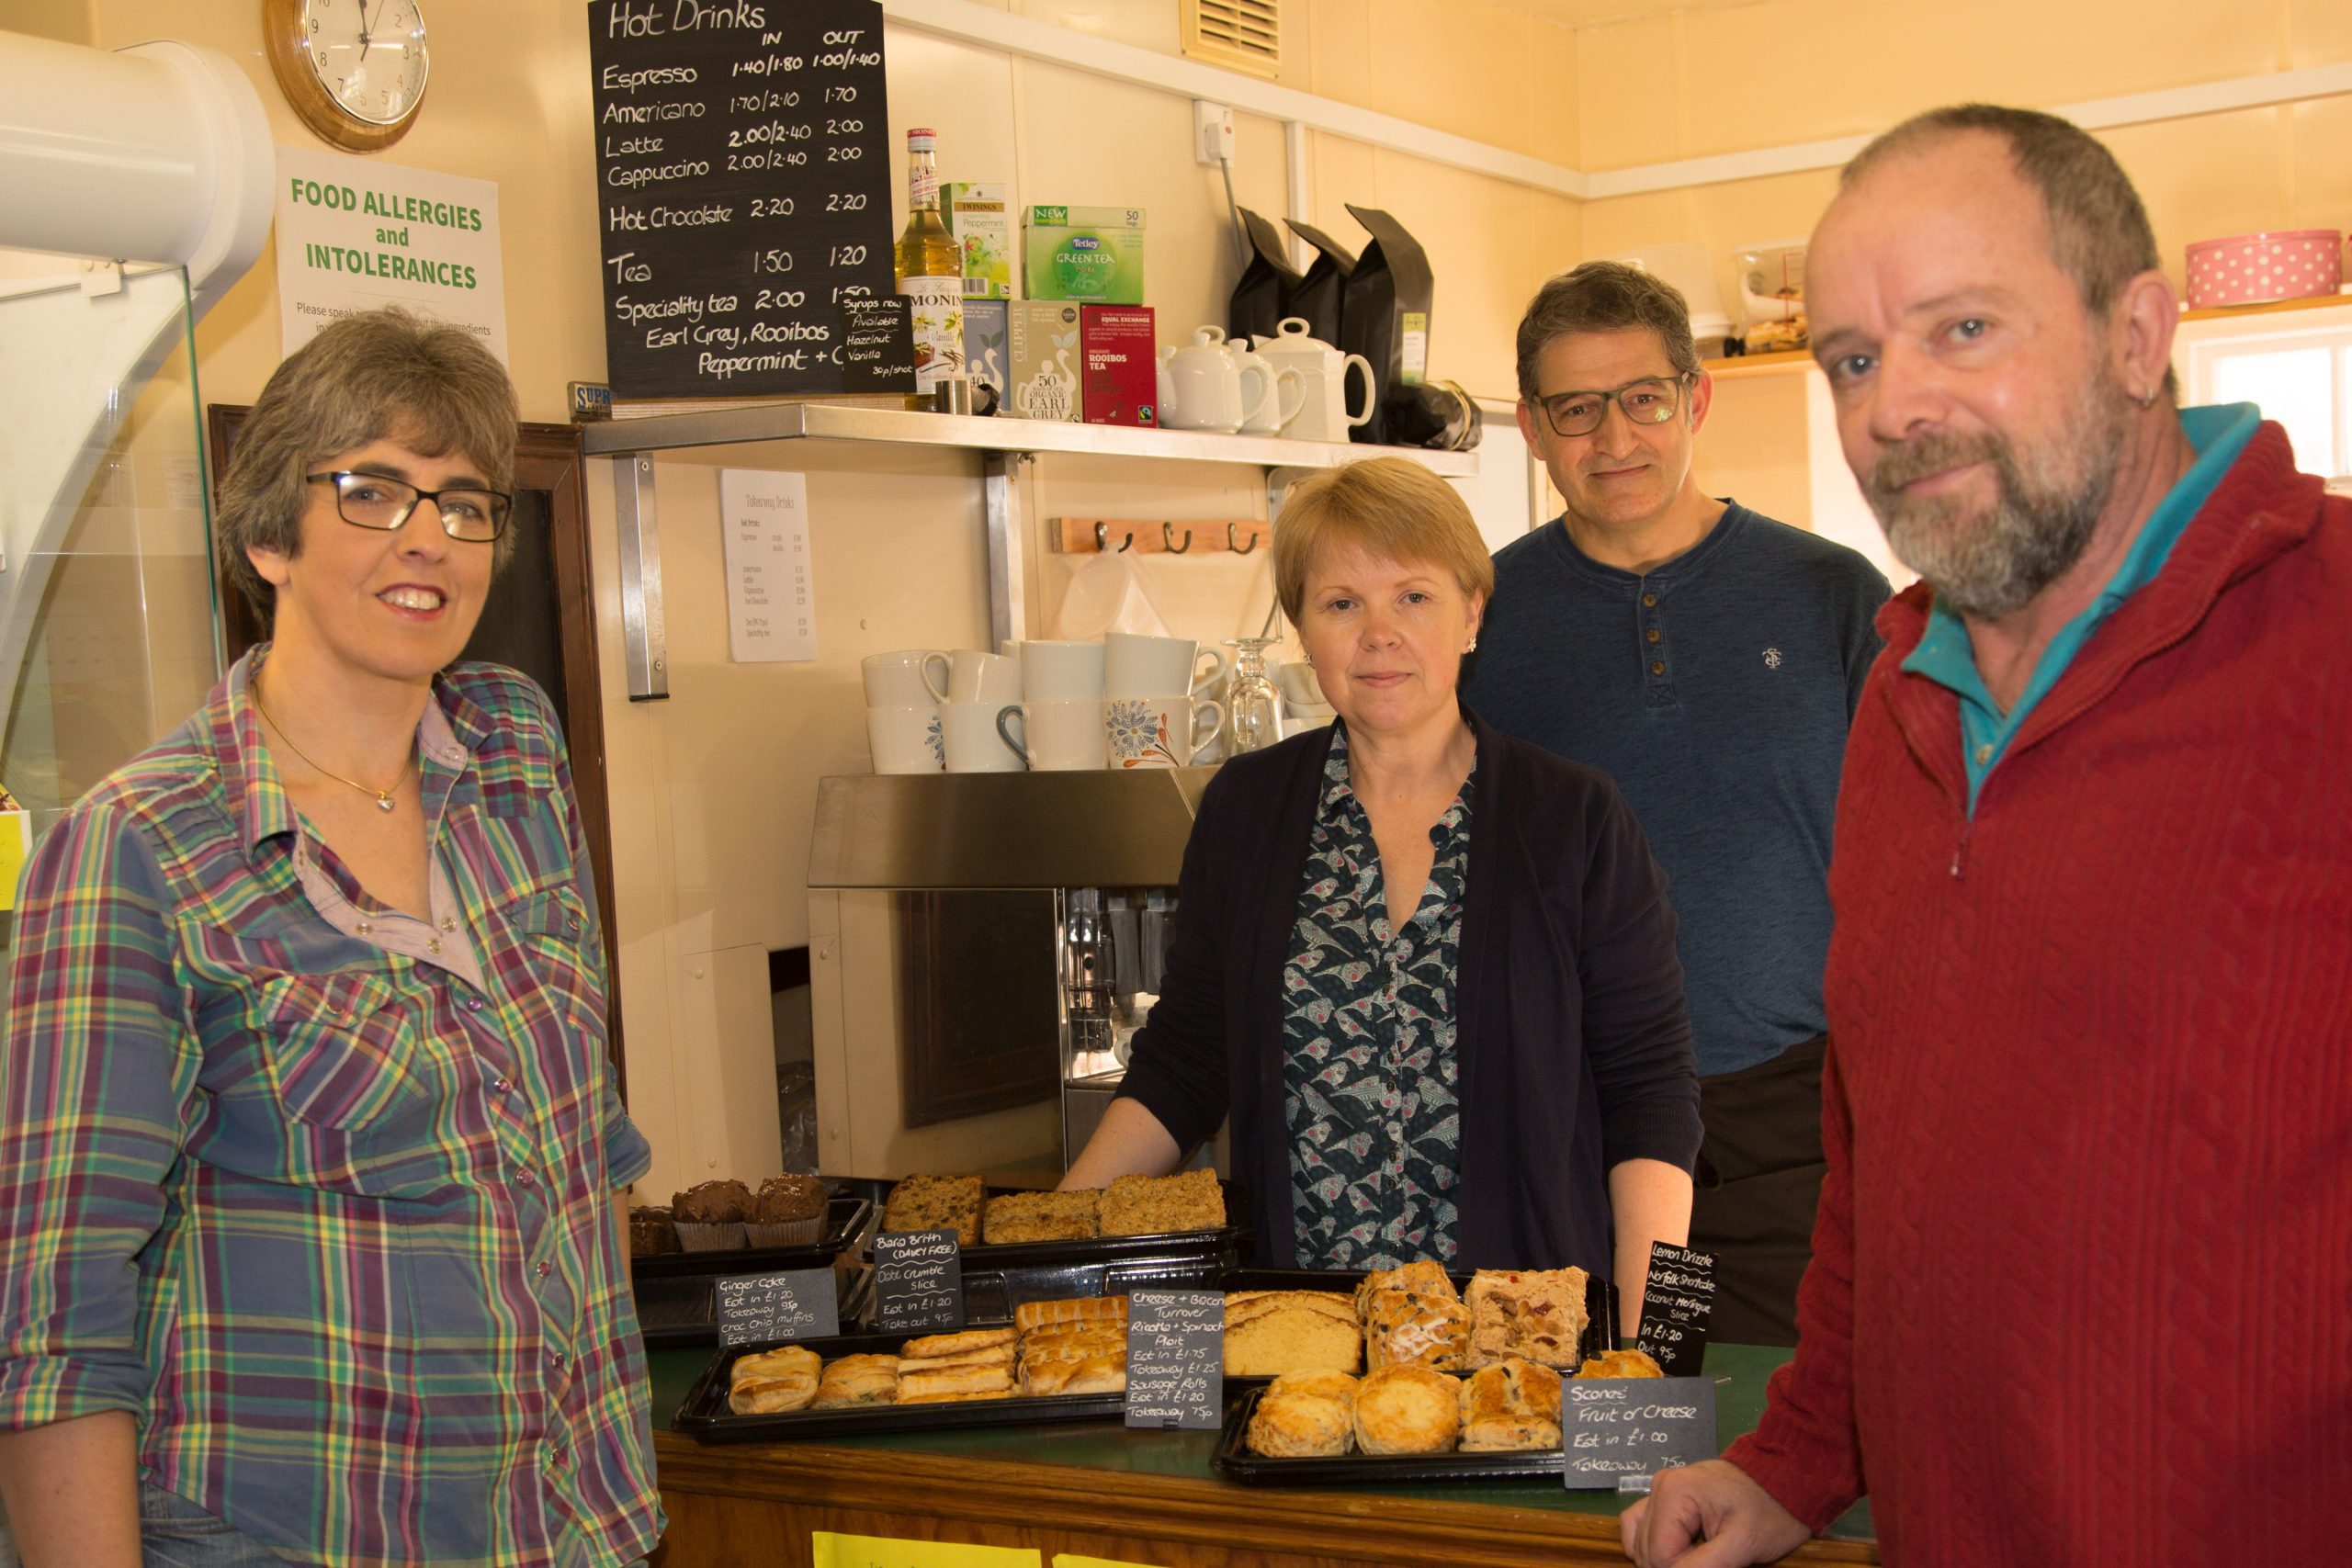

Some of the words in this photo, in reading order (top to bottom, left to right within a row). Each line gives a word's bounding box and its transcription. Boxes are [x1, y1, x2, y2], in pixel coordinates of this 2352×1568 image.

[312, 19, 319, 34] 9
[395, 14, 402, 28] 2
[609, 1, 665, 39] Hot
[673, 0, 765, 30] Drinks
[762, 31, 782, 46] IN
[823, 30, 865, 44] OUT
[320, 52, 327, 67] 8
[403, 46, 409, 60] 3
[338, 78, 345, 92] 7
[397, 74, 403, 88] 4
[603, 65, 697, 94] Espresso
[381, 90, 388, 105] 5
[603, 101, 706, 124] Americano
[605, 137, 664, 158] Latte
[607, 161, 710, 189] Cappuccino
[291, 178, 356, 211] FOOD
[363, 191, 482, 231] ALLERGIES
[610, 206, 649, 231] Hot
[650, 205, 734, 228] Chocolate
[1035, 209, 1066, 218] NEW
[1126, 211, 1138, 220] 50
[963, 219, 1003, 228] Peppermint
[376, 227, 409, 247] and
[1073, 239, 1099, 249] Tetley
[306, 243, 477, 289] INTOLERANCES
[1057, 254, 1091, 264] GREEN
[1094, 254, 1115, 264] TEA
[607, 252, 652, 285] Tea
[297, 302, 327, 317] Please
[329, 308, 355, 320] speak
[616, 295, 705, 326] Speciality
[708, 293, 738, 313] tea
[843, 299, 879, 313] Syrups
[852, 313, 899, 328] Available
[646, 326, 688, 349] Earl
[751, 321, 830, 343] Rooibos
[846, 333, 891, 345] Hazelnut
[1013, 308, 1023, 362] CLIPPER
[848, 348, 880, 361] Vanilla
[698, 349, 808, 380] Peppermint
[1038, 375, 1057, 386] 50
[1029, 398, 1069, 409] EARL
[1033, 410, 1065, 420] GREY
[876, 1237, 906, 1249] Bara
[909, 1234, 942, 1246] Brith
[1652, 1244, 1679, 1260] Lemon
[1681, 1250, 1713, 1267] Drizzle
[877, 1270, 901, 1283] Date
[720, 1280, 757, 1296] Ginger
[759, 1277, 786, 1288] Cake
[724, 1298, 745, 1307] Eat
[1133, 1293, 1176, 1304] Cheese
[1191, 1295, 1224, 1305] Bacon
[1645, 1291, 1675, 1305] Coconut
[1676, 1297, 1711, 1316] Meringue
[724, 1307, 775, 1318] Takeaway
[782, 1301, 797, 1313] 95p
[884, 1303, 903, 1314] Eat
[1155, 1306, 1209, 1318] Turnover
[935, 1313, 954, 1325] 95p
[1131, 1322, 1170, 1332] Ricotta
[1182, 1322, 1224, 1333] Spinach
[728, 1335, 747, 1345] Eat
[1155, 1335, 1185, 1347] Plait
[1134, 1350, 1155, 1360] Eat
[1638, 1341, 1656, 1353] Out
[1659, 1346, 1676, 1363] 95p
[1130, 1364, 1183, 1379] Takeaway
[1130, 1380, 1177, 1392] Sausage
[1181, 1378, 1207, 1389] Rolls
[1130, 1393, 1153, 1402] Eat
[1127, 1406, 1184, 1421] Takeaway
[1192, 1405, 1213, 1420] 75p
[1578, 1406, 1619, 1422] Fruit
[1623, 1407, 1643, 1421] or
[1644, 1405, 1697, 1419] Cheese
[1573, 1433, 1600, 1448] Eat
[1606, 1433, 1620, 1445] in
[1573, 1457, 1647, 1474] Takeaway
